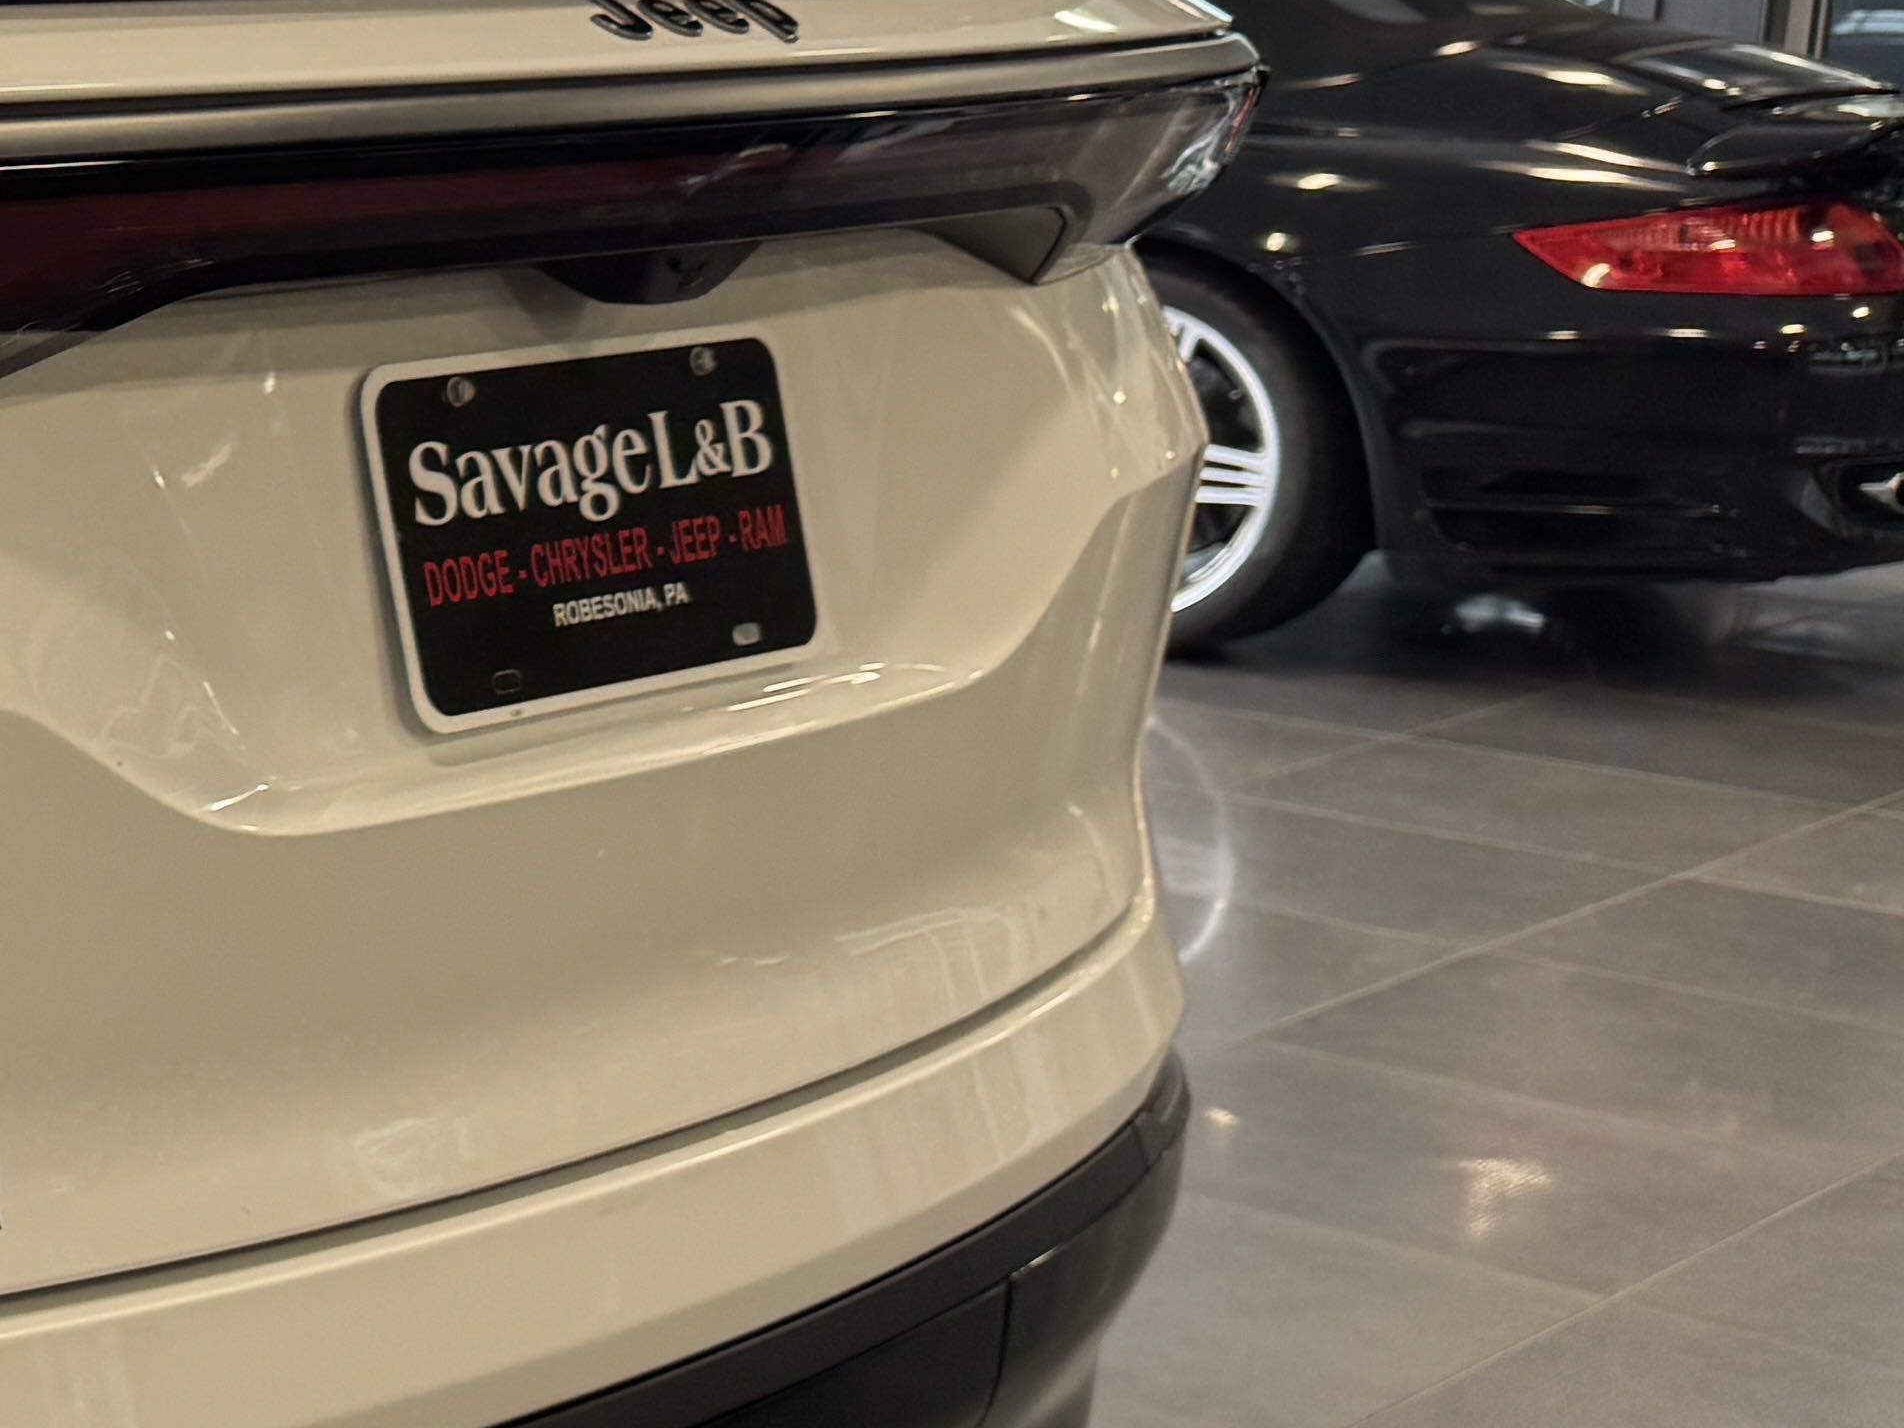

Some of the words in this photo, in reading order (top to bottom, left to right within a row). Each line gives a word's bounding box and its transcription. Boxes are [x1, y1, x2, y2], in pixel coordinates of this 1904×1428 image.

[424, 549, 515, 608] DODGE
[530, 527, 654, 588] CHRYSLER
[667, 516, 721, 565] JEEP
[739, 504, 788, 551] RAM
[665, 581, 690, 607] PA
